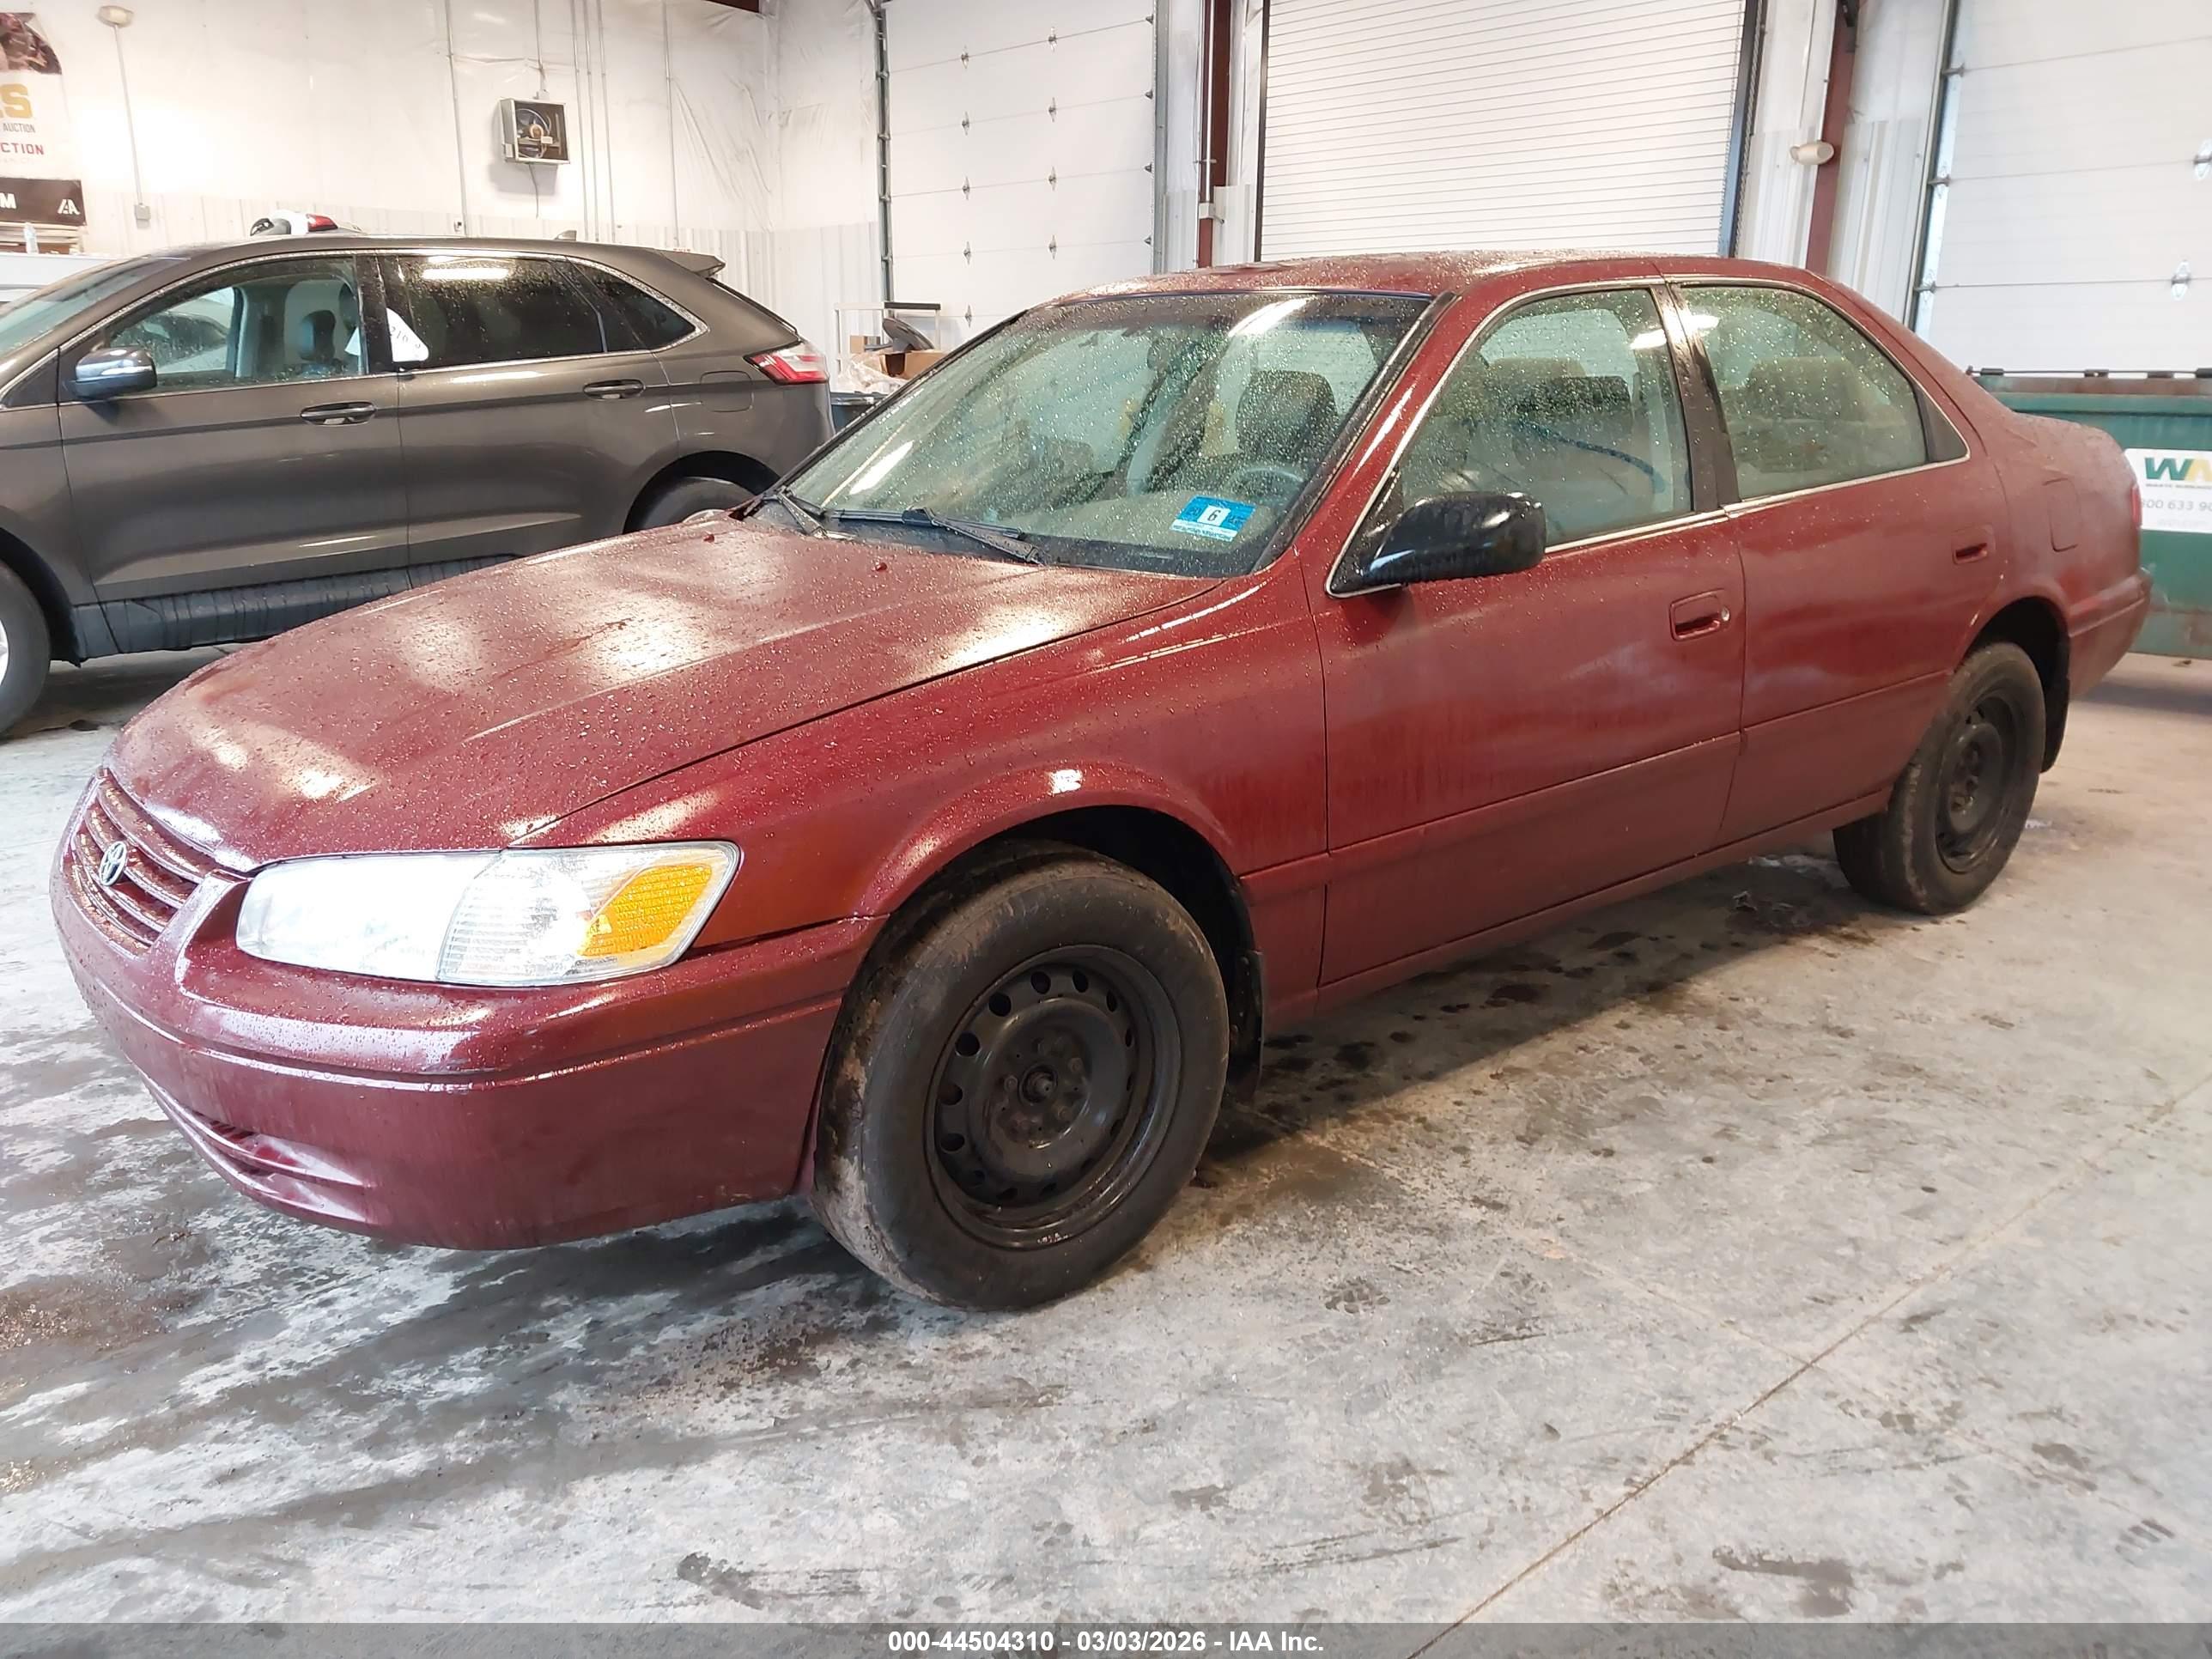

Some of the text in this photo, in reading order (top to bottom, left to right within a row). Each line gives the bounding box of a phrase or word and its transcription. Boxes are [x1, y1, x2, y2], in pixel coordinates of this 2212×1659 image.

[0, 83, 33, 118] S
[3, 123, 35, 133] AUCTION
[0, 142, 44, 155] CTION
[2142, 499, 2164, 509] 00
[2167, 500, 2194, 511] 633
[1206, 509, 1221, 522] 6
